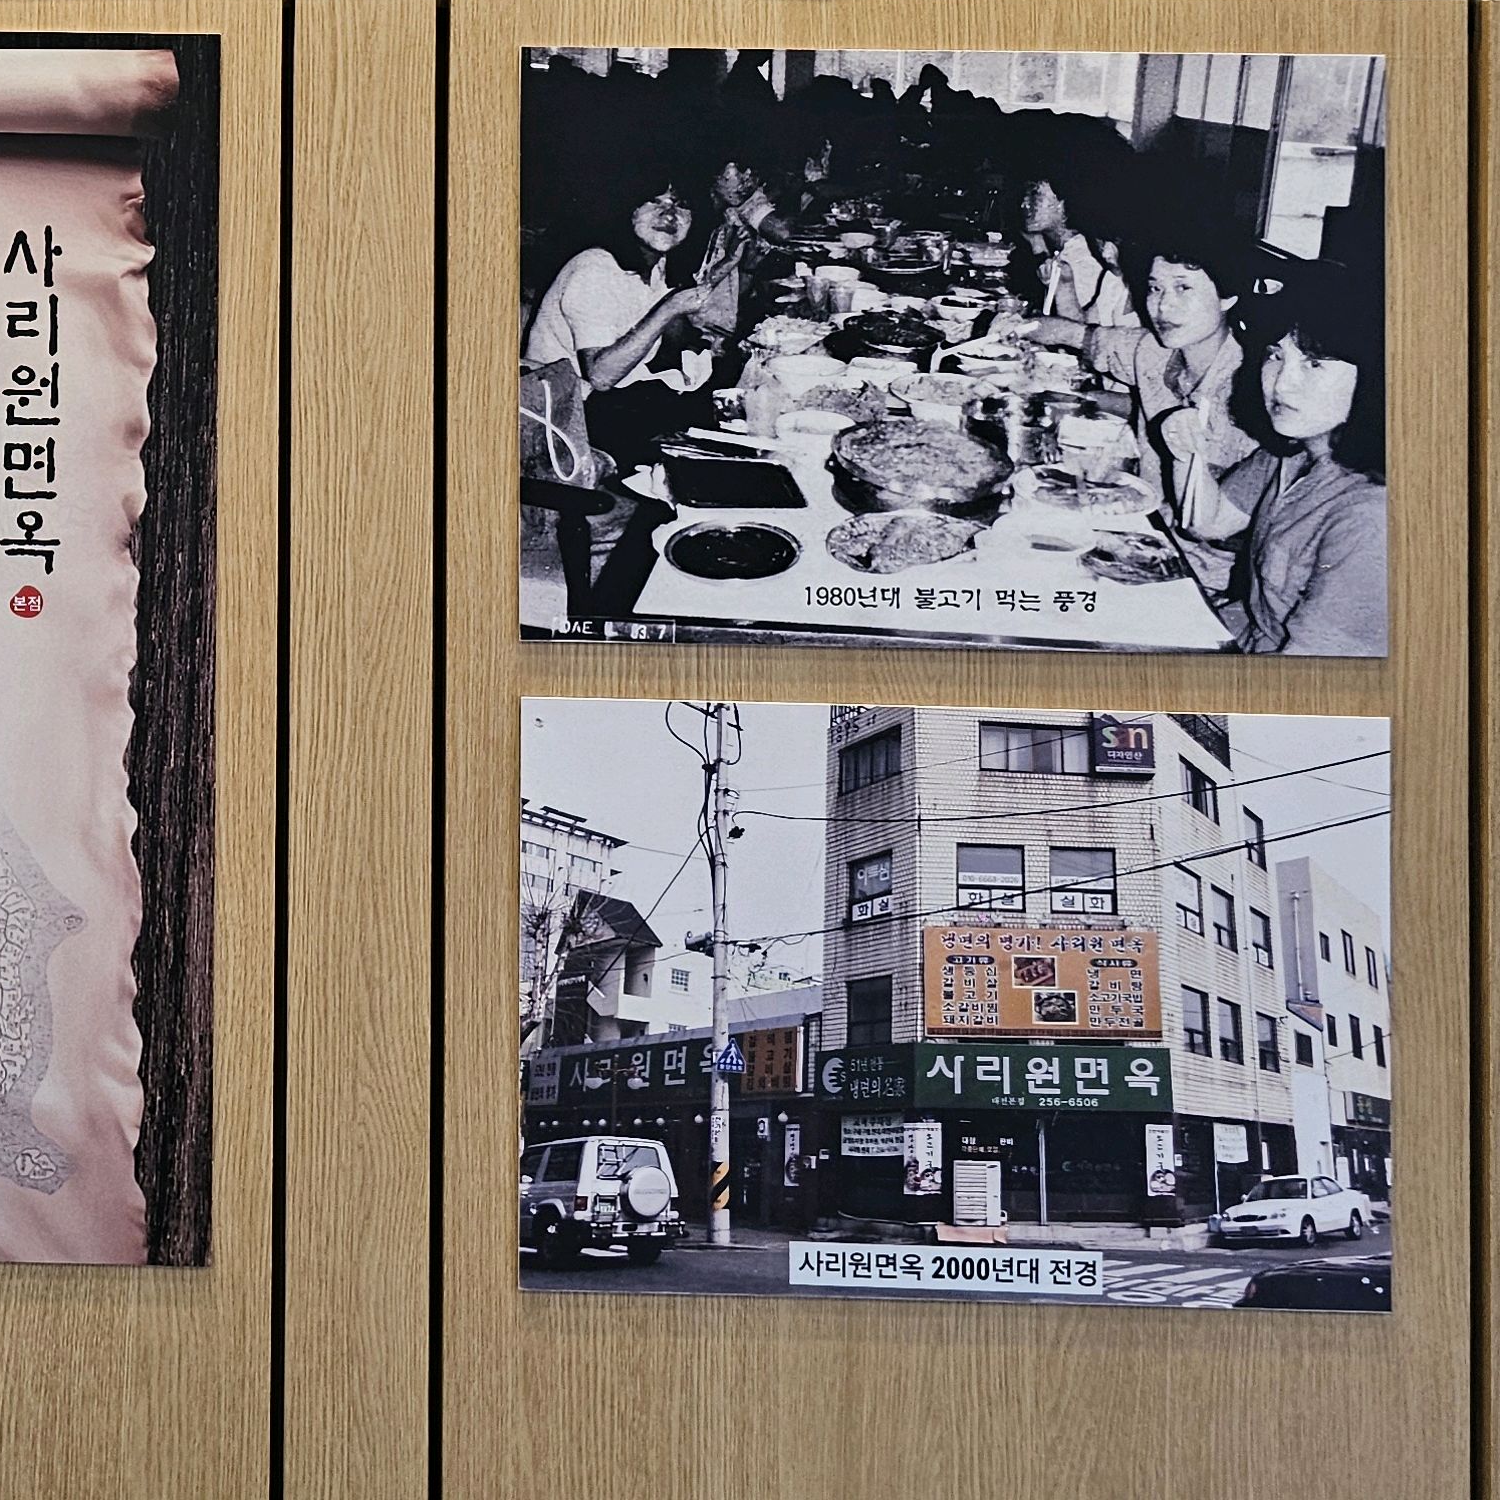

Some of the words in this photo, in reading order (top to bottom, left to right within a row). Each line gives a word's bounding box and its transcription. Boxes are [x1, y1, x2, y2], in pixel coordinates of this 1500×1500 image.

[12, 594, 43, 613] 본점
[804, 586, 901, 610] 1980년대
[914, 587, 981, 612] 불고기
[995, 589, 1041, 612] 먹는
[1052, 590, 1097, 613] 풍경
[941, 932, 991, 950] 냉면의
[1050, 934, 1104, 953] 사리원
[942, 1013, 999, 1026] 돼지갈비
[926, 1055, 1161, 1097] 사리원면옥
[1038, 1097, 1099, 1108] 256-6506
[798, 1250, 925, 1281] 사리원면옥
[931, 1255, 1040, 1285] 2000년대
[1048, 1258, 1097, 1287] 전경
